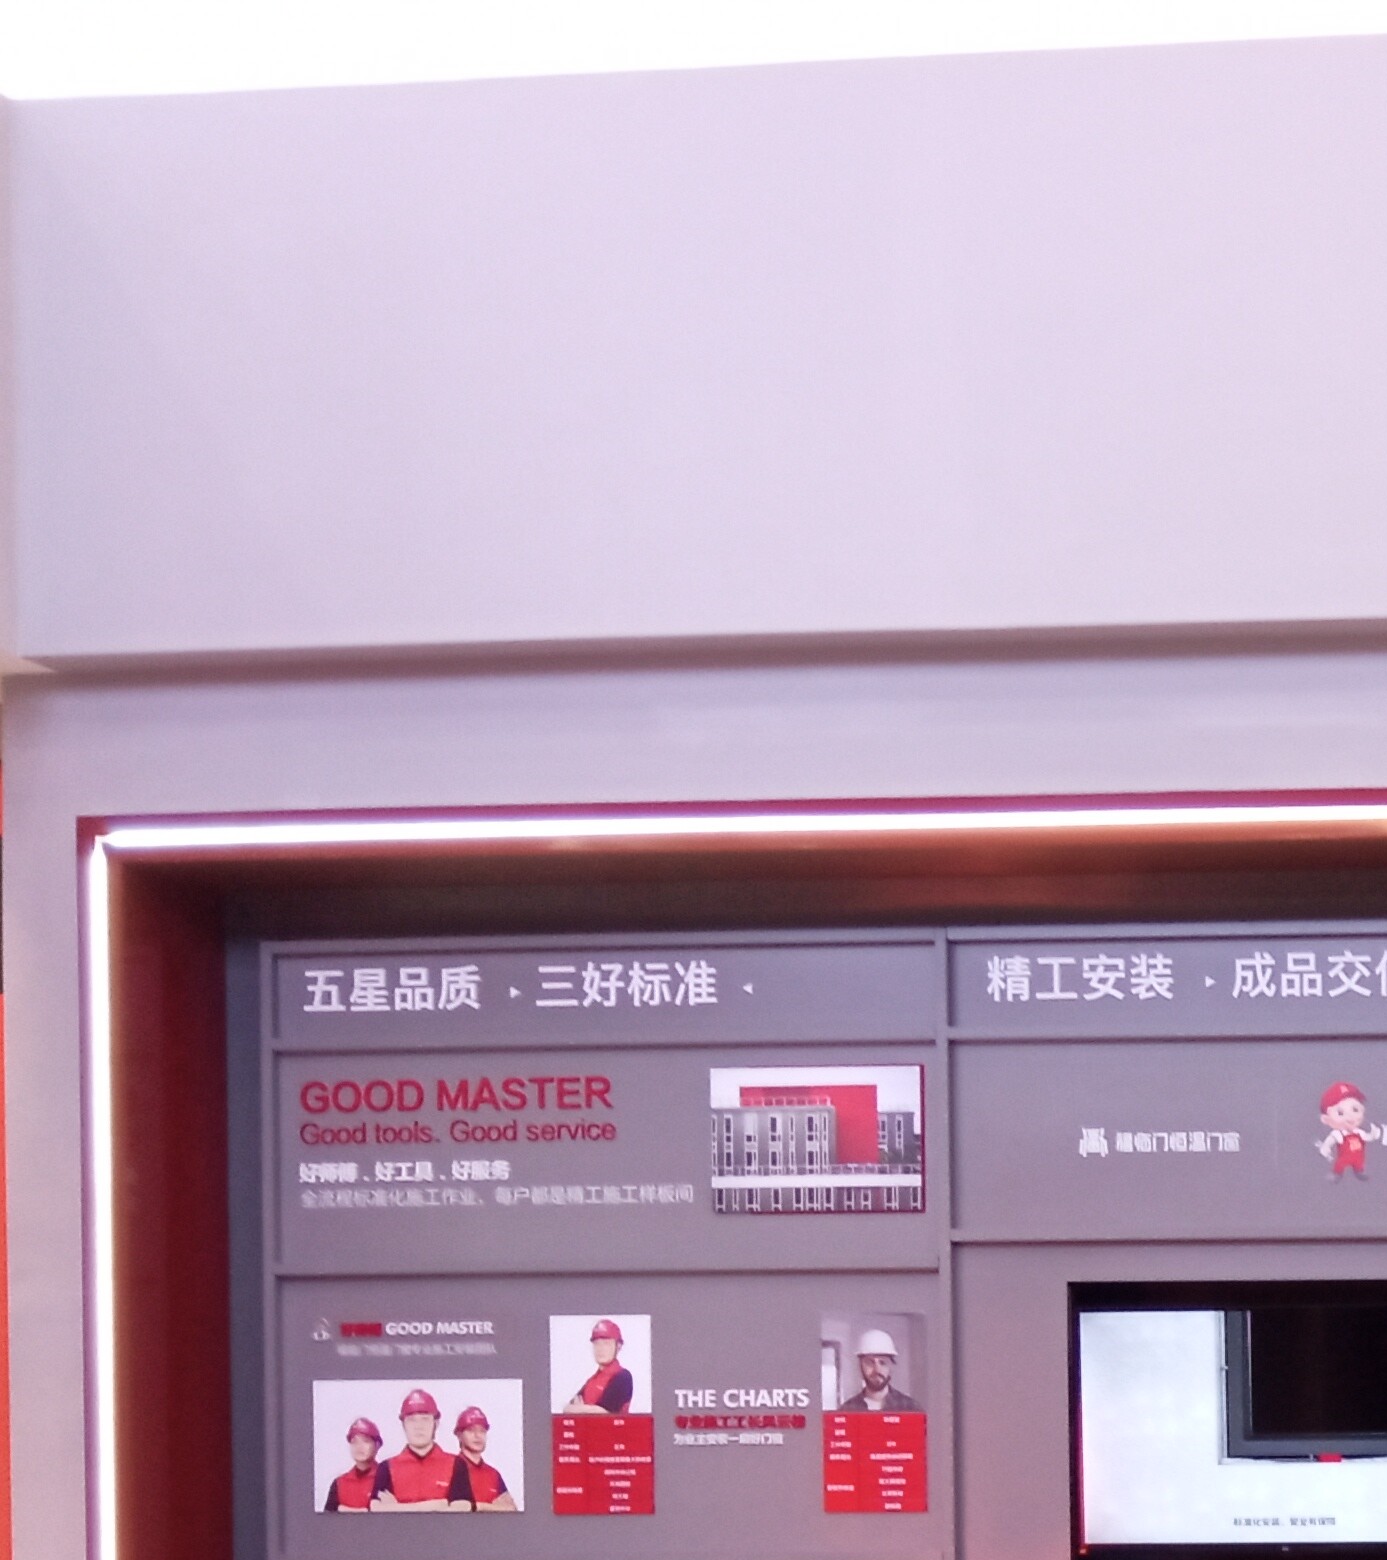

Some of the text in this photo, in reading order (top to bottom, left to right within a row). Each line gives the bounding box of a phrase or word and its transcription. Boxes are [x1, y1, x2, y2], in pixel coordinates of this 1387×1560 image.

[303, 960, 719, 1013] 五星品质 三好标准
[986, 953, 1175, 1002] 精工安装
[300, 1075, 614, 1114] GOOD MASTER
[300, 1118, 617, 1145] Good tools. Good service
[385, 1322, 433, 1335] GOOD
[436, 1321, 495, 1335] MASTER
[674, 1388, 810, 1409] THE CHARTS
